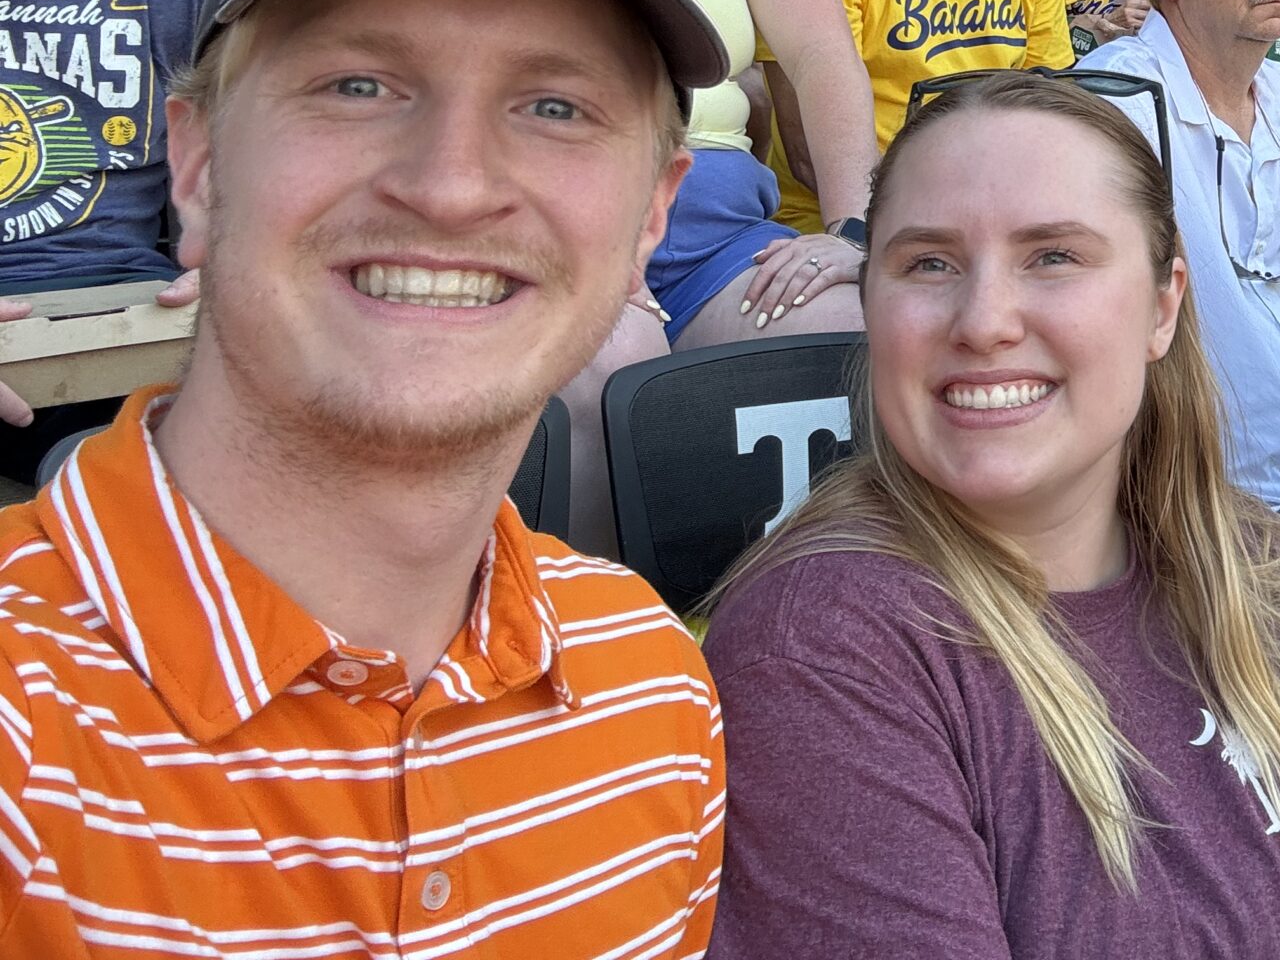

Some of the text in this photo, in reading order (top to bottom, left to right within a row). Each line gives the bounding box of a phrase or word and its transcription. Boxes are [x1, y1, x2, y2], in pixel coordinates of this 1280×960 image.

[3, 200, 64, 241] SHOW
[52, 184, 84, 211] IN
[735, 396, 852, 538] T
